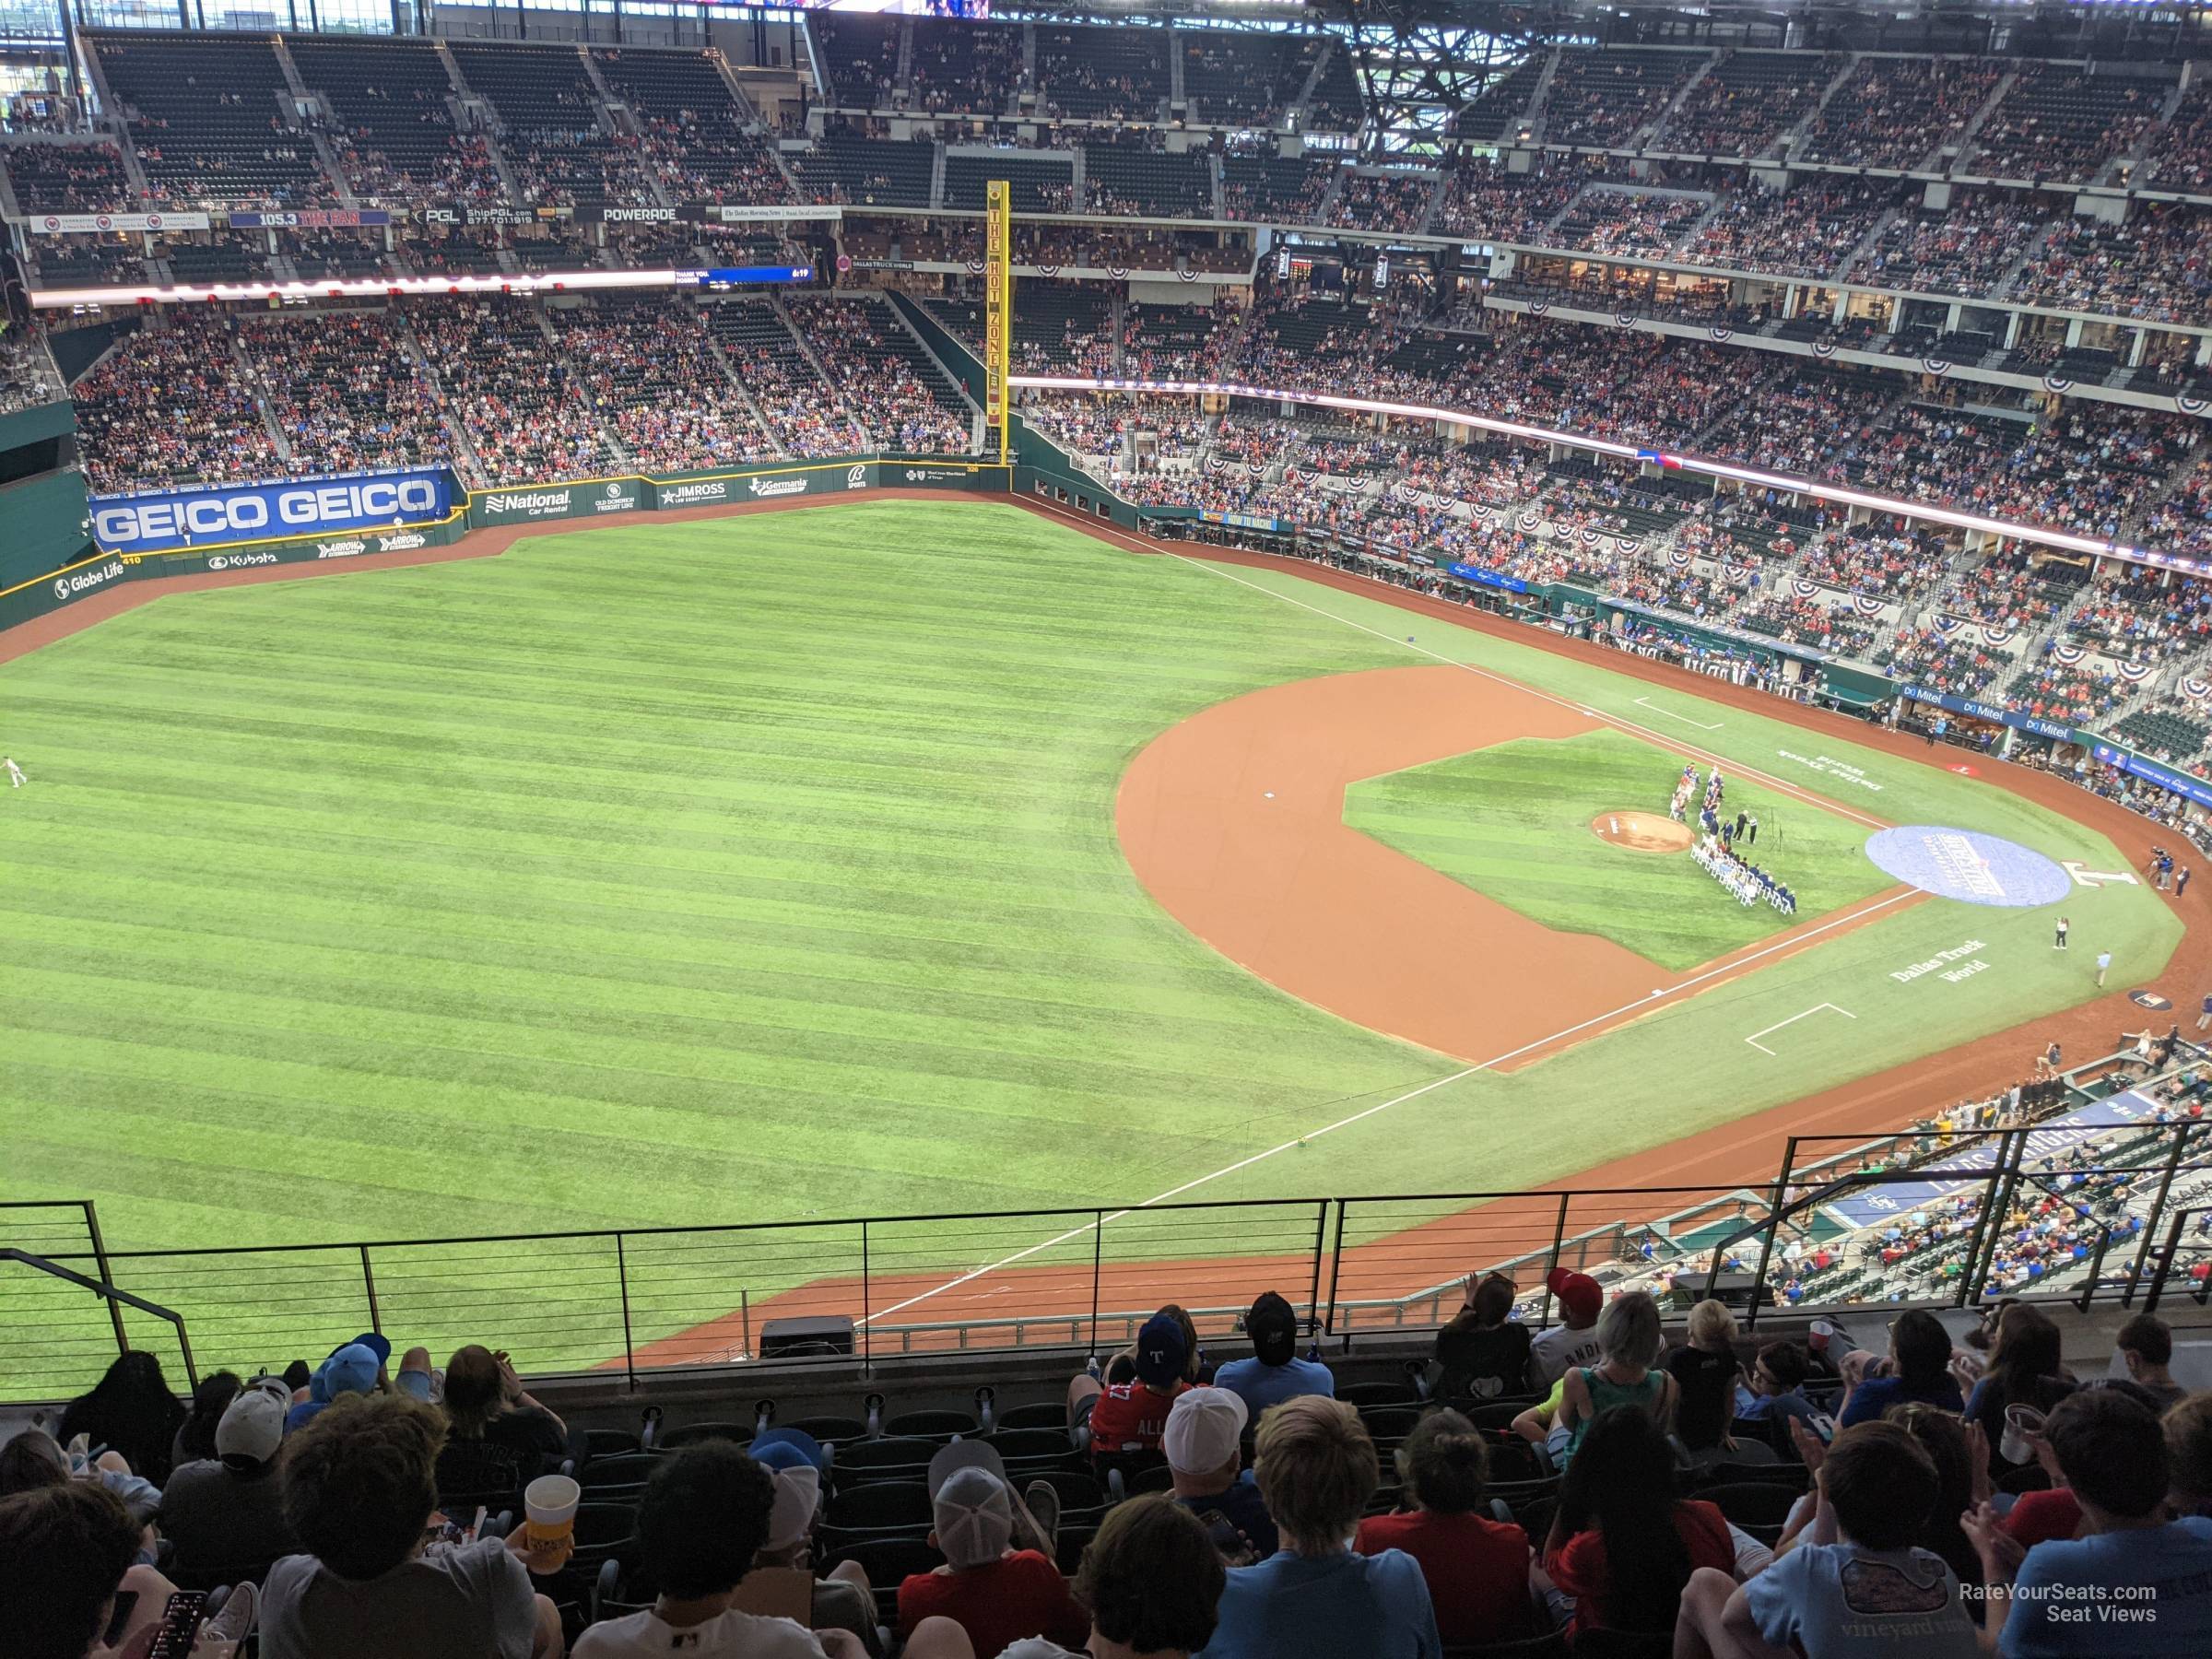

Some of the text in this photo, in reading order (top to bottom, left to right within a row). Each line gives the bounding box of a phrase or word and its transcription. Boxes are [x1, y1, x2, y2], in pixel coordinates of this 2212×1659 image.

[259, 210, 360, 226] 105.3 THE FAN
[426, 209, 460, 222] PGL
[466, 208, 532, 218] ShipPGL.com
[604, 208, 677, 221] POWERADE
[467, 217, 533, 225] 877.701.1919
[793, 268, 808, 277] 6:19
[989, 209, 1001, 366] THE HOT ZONE
[767, 478, 806, 490] Germania
[848, 481, 866, 489] SPORTS
[96, 479, 436, 543] GEICO GEICO
[544, 505, 568, 514] Rental
[391, 534, 420, 545] ARROW
[330, 541, 360, 552] ARROW
[123, 556, 141, 565] 410
[230, 553, 278, 566] Kubota
[71, 562, 124, 592] Globe Life
[1916, 689, 1943, 704] Mitel
[1977, 705, 2005, 721] Mitel
[2040, 723, 2069, 738] Mitel
[1889, 939, 1987, 982] Dallas Truck
[1938, 959, 1991, 982] World
[1150, 1350, 1164, 1364] T
[1841, 1617, 1935, 1642] vineyard
